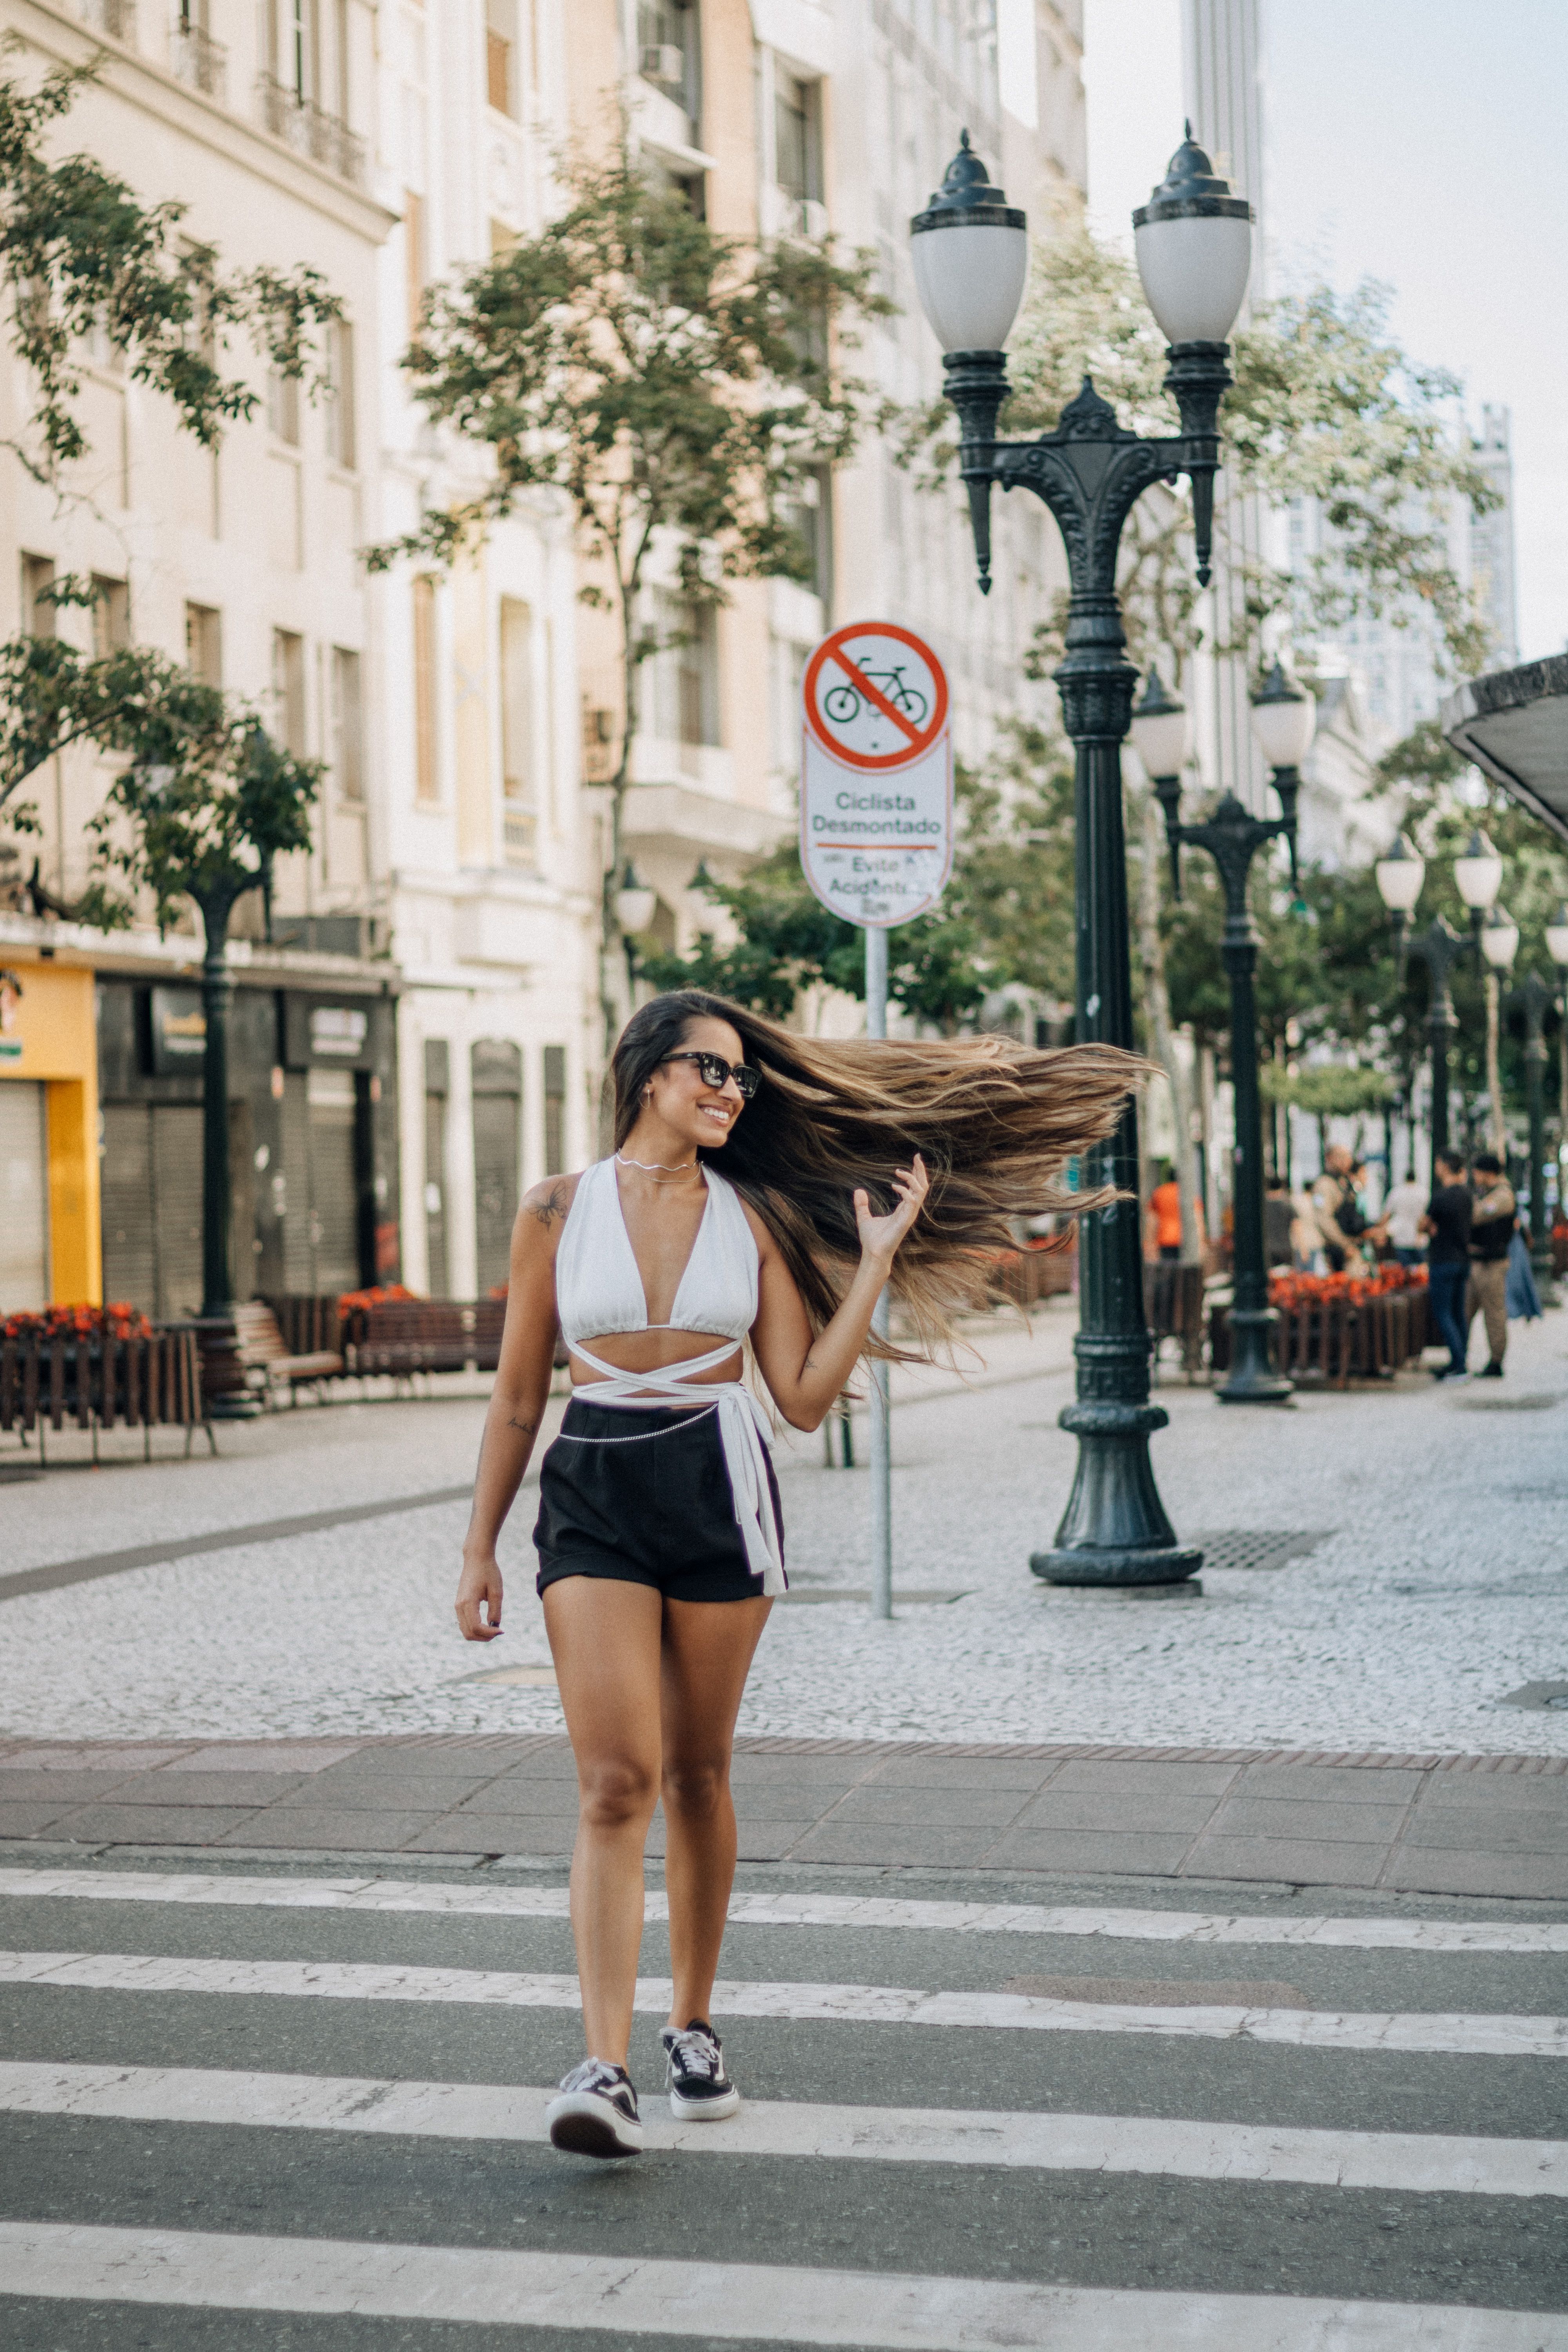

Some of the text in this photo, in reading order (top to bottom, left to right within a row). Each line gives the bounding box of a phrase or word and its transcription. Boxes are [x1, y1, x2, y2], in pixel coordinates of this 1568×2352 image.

[836, 792, 915, 811] Ciclista
[813, 815, 941, 834] Desmontado
[853, 857, 899, 872] Evite
